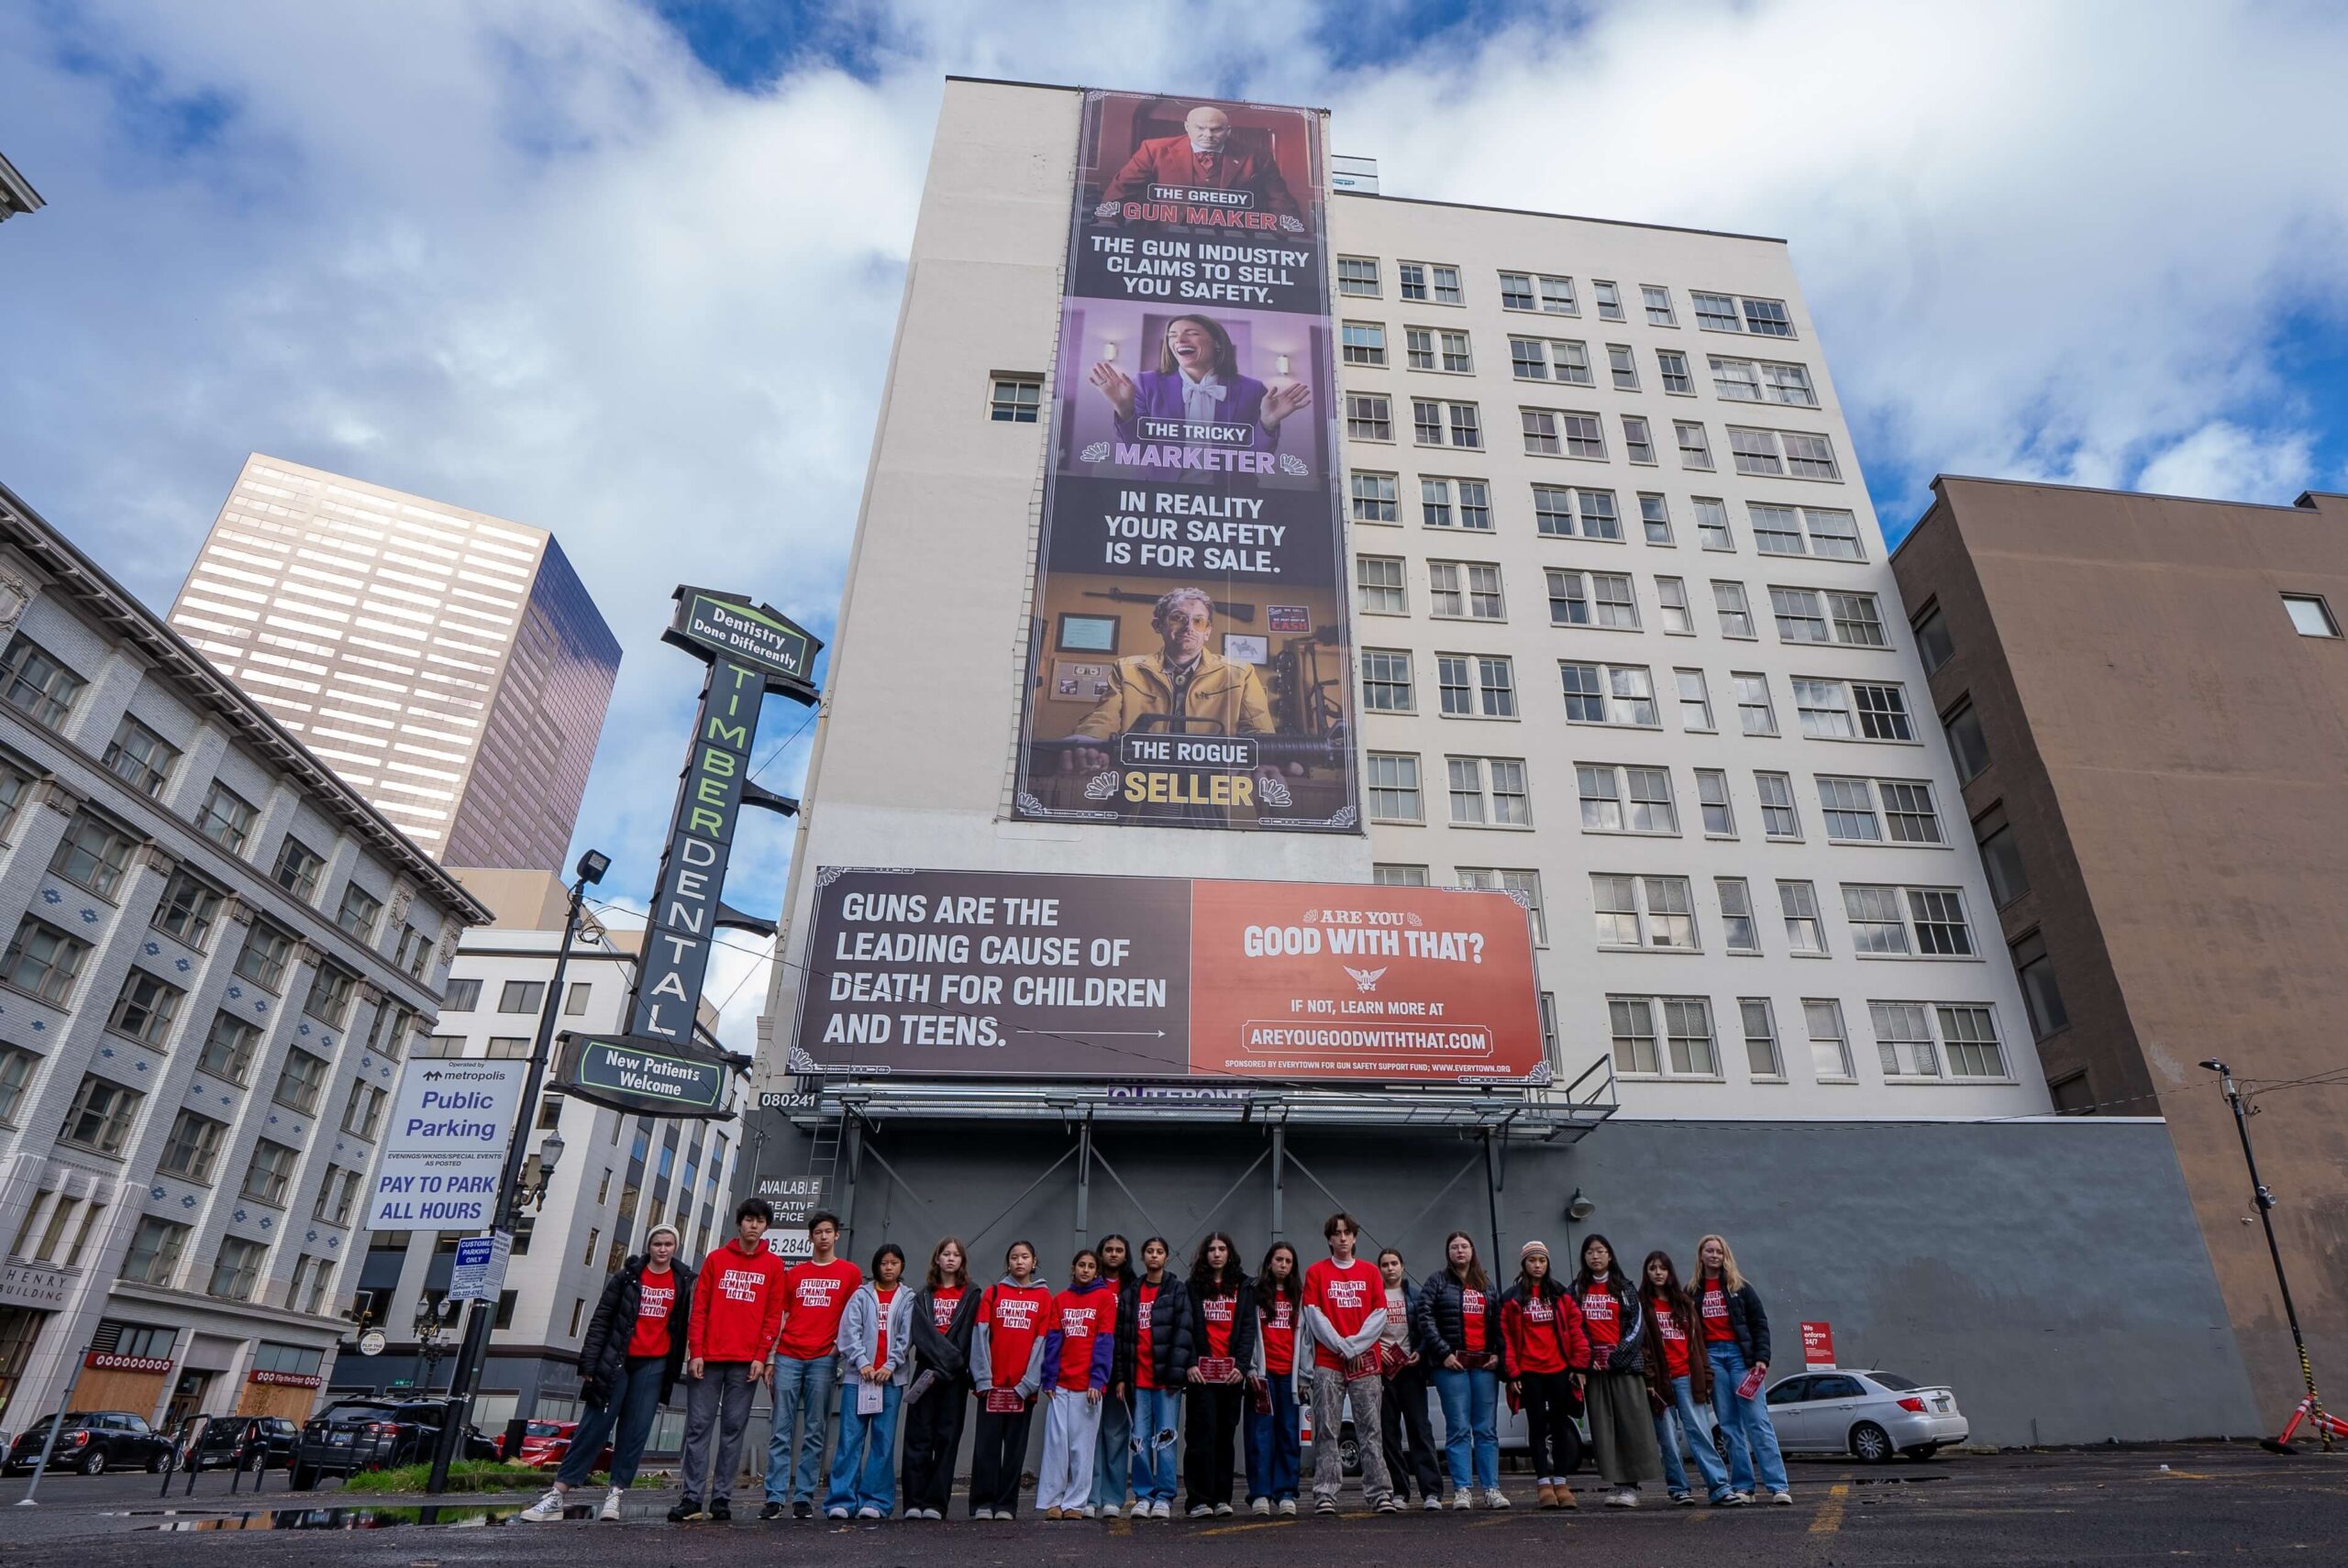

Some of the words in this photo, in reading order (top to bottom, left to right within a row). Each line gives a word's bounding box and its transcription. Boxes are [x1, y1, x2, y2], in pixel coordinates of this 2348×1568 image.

[1154, 187, 1183, 199] THE
[1188, 190, 1248, 204] GREEDY
[1122, 202, 1178, 223] GUN
[1186, 207, 1278, 230] MAKER
[1091, 236, 1134, 254] THE
[1142, 240, 1191, 258] GUN
[1199, 244, 1309, 268] INDUSTRY
[1106, 257, 1195, 278] CLAIMS
[1202, 263, 1230, 281] TO
[1238, 267, 1294, 286] SELL
[1123, 277, 1171, 295] YOU
[1180, 282, 1274, 304] SAFETY.
[1146, 422, 1179, 437] THE
[1182, 424, 1246, 442] TRICKY
[1114, 442, 1276, 475] MARKETER
[1120, 491, 1146, 512] IN
[1156, 492, 1264, 519] REALITY
[1104, 515, 1178, 540] YOUR
[1187, 520, 1286, 547] SAFETY
[1105, 542, 1131, 564] IS
[1140, 544, 1195, 569] FOR
[1203, 549, 1280, 573] SALE.
[713, 607, 786, 648] Dentistry
[694, 618, 726, 641] Done
[730, 632, 796, 669] Differently
[689, 663, 756, 838] TIMBER
[1131, 740, 1170, 760] THE
[1177, 743, 1248, 764] ROGUE
[1124, 770, 1254, 807] SELLER
[842, 892, 927, 923] GUNS
[934, 896, 996, 924] ARE
[1003, 898, 1059, 926] THE
[1321, 910, 1362, 924] ARE
[1366, 911, 1404, 926] YOU
[648, 837, 716, 1036] DENTAL
[1244, 925, 1322, 957] GOOD
[1325, 928, 1400, 957] WITH
[1404, 930, 1485, 964] THAT?
[835, 932, 970, 964] LEADING
[980, 935, 1080, 966] CAUSE
[1090, 939, 1130, 966] OF
[829, 972, 931, 1003] DEATH
[940, 975, 1002, 1005] FOR
[1013, 976, 1166, 1008] CHILDREN
[1290, 999, 1303, 1012] IF
[1307, 1000, 1336, 1016] NOT,
[1341, 1001, 1384, 1015] LEARN
[1388, 1002, 1425, 1016] MORE
[1428, 1002, 1445, 1016] AT
[823, 1013, 891, 1044] AND
[900, 1015, 1006, 1047] TEENS.
[1250, 1029, 1486, 1050] AREYOUGOODWITHTHAT.COM
[605, 1050, 640, 1070] New
[644, 1057, 701, 1081] Patients
[1224, 1060, 1267, 1068] SPONSORED
[1278, 1061, 1320, 1069] EVERYTOWN
[1322, 1061, 1335, 1069] FOR
[1352, 1062, 1377, 1070] SAFETY
[1379, 1063, 1410, 1071] SUPPORT
[1410, 1063, 1430, 1072] FUND;
[1432, 1064, 1511, 1073] WWW.EVERYTOWN.ORG
[444, 1071, 505, 1082] metropolis
[620, 1070, 682, 1096] Welcome
[421, 1091, 494, 1110] Public
[761, 1094, 815, 1107] 080241
[405, 1119, 496, 1142] Parking
[380, 1176, 415, 1193] PAY
[419, 1176, 442, 1193] TO
[447, 1176, 496, 1193] PARK
[380, 1202, 413, 1220] ALL
[419, 1202, 482, 1220] HOURS
[773, 1212, 804, 1221] FFICE
[767, 1238, 812, 1253] 5.2840
[6, 1269, 67, 1287] HENRY
[719, 1279, 750, 1290] DEMAND
[725, 1270, 765, 1284] STUDENTS
[801, 1279, 839, 1288] STUDENTS
[1331, 1281, 1366, 1290] STUDENTS
[726, 1290, 755, 1301] ACTION
[796, 1287, 825, 1297] DEMAND
[803, 1297, 830, 1306] ACTION
[1328, 1289, 1355, 1298] DEMAND
[1001, 1299, 1038, 1311] STUDENTS
[1204, 1302, 1224, 1310] MAND
[1338, 1297, 1362, 1307] ACTION
[997, 1308, 1025, 1319] DEMAND
[1004, 1318, 1030, 1329] ACTION
